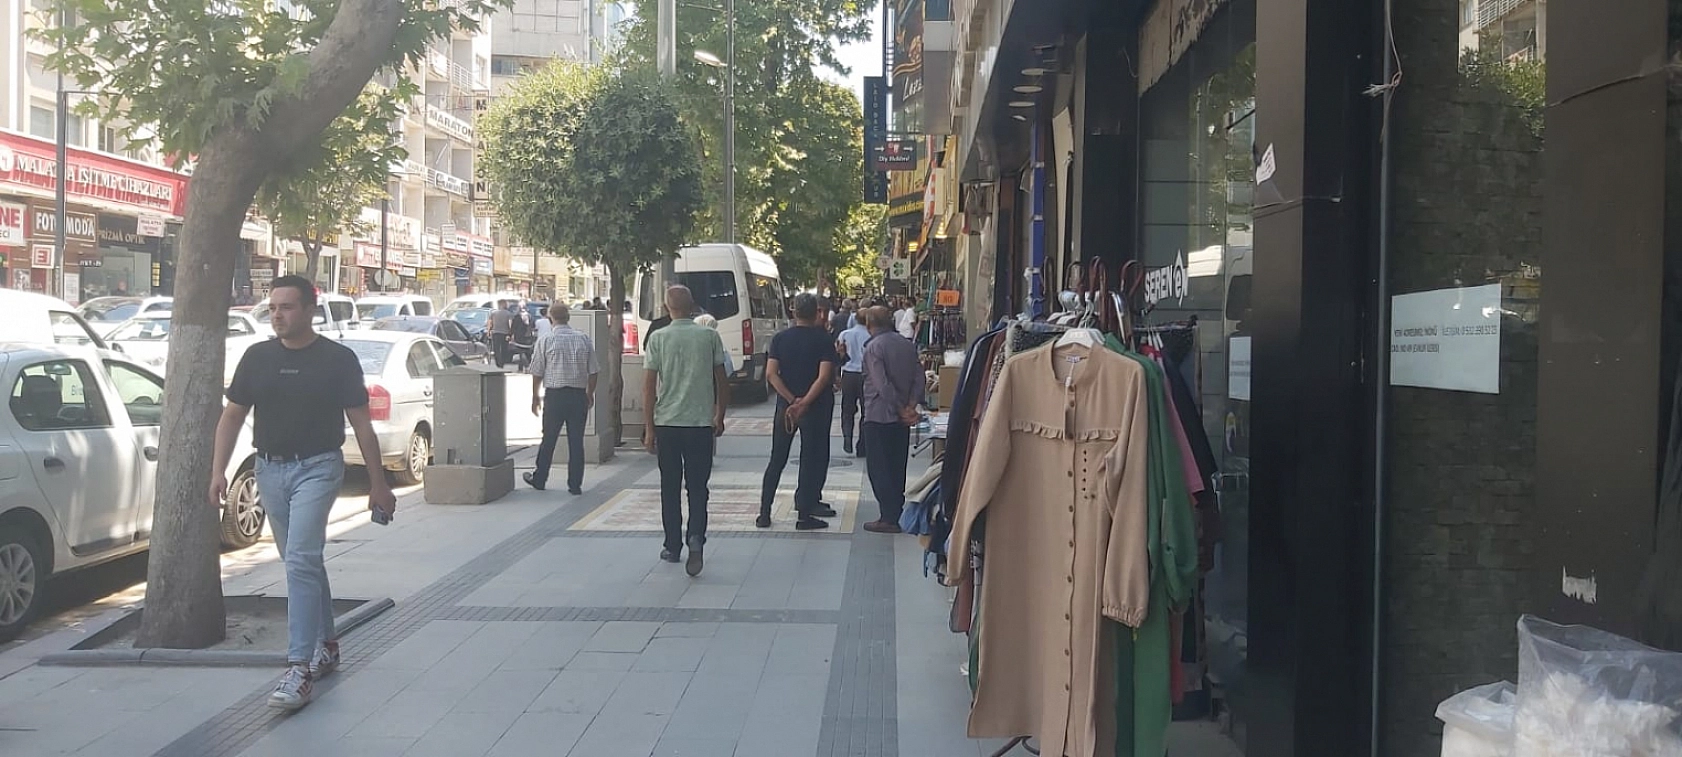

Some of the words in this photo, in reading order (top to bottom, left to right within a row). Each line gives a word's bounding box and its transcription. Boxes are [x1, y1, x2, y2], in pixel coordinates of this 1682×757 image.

[18, 155, 75, 181] MALAA
[35, 211, 57, 232] FOT
[65, 215, 95, 237] MODA
[1144, 265, 1173, 305] SEREN
